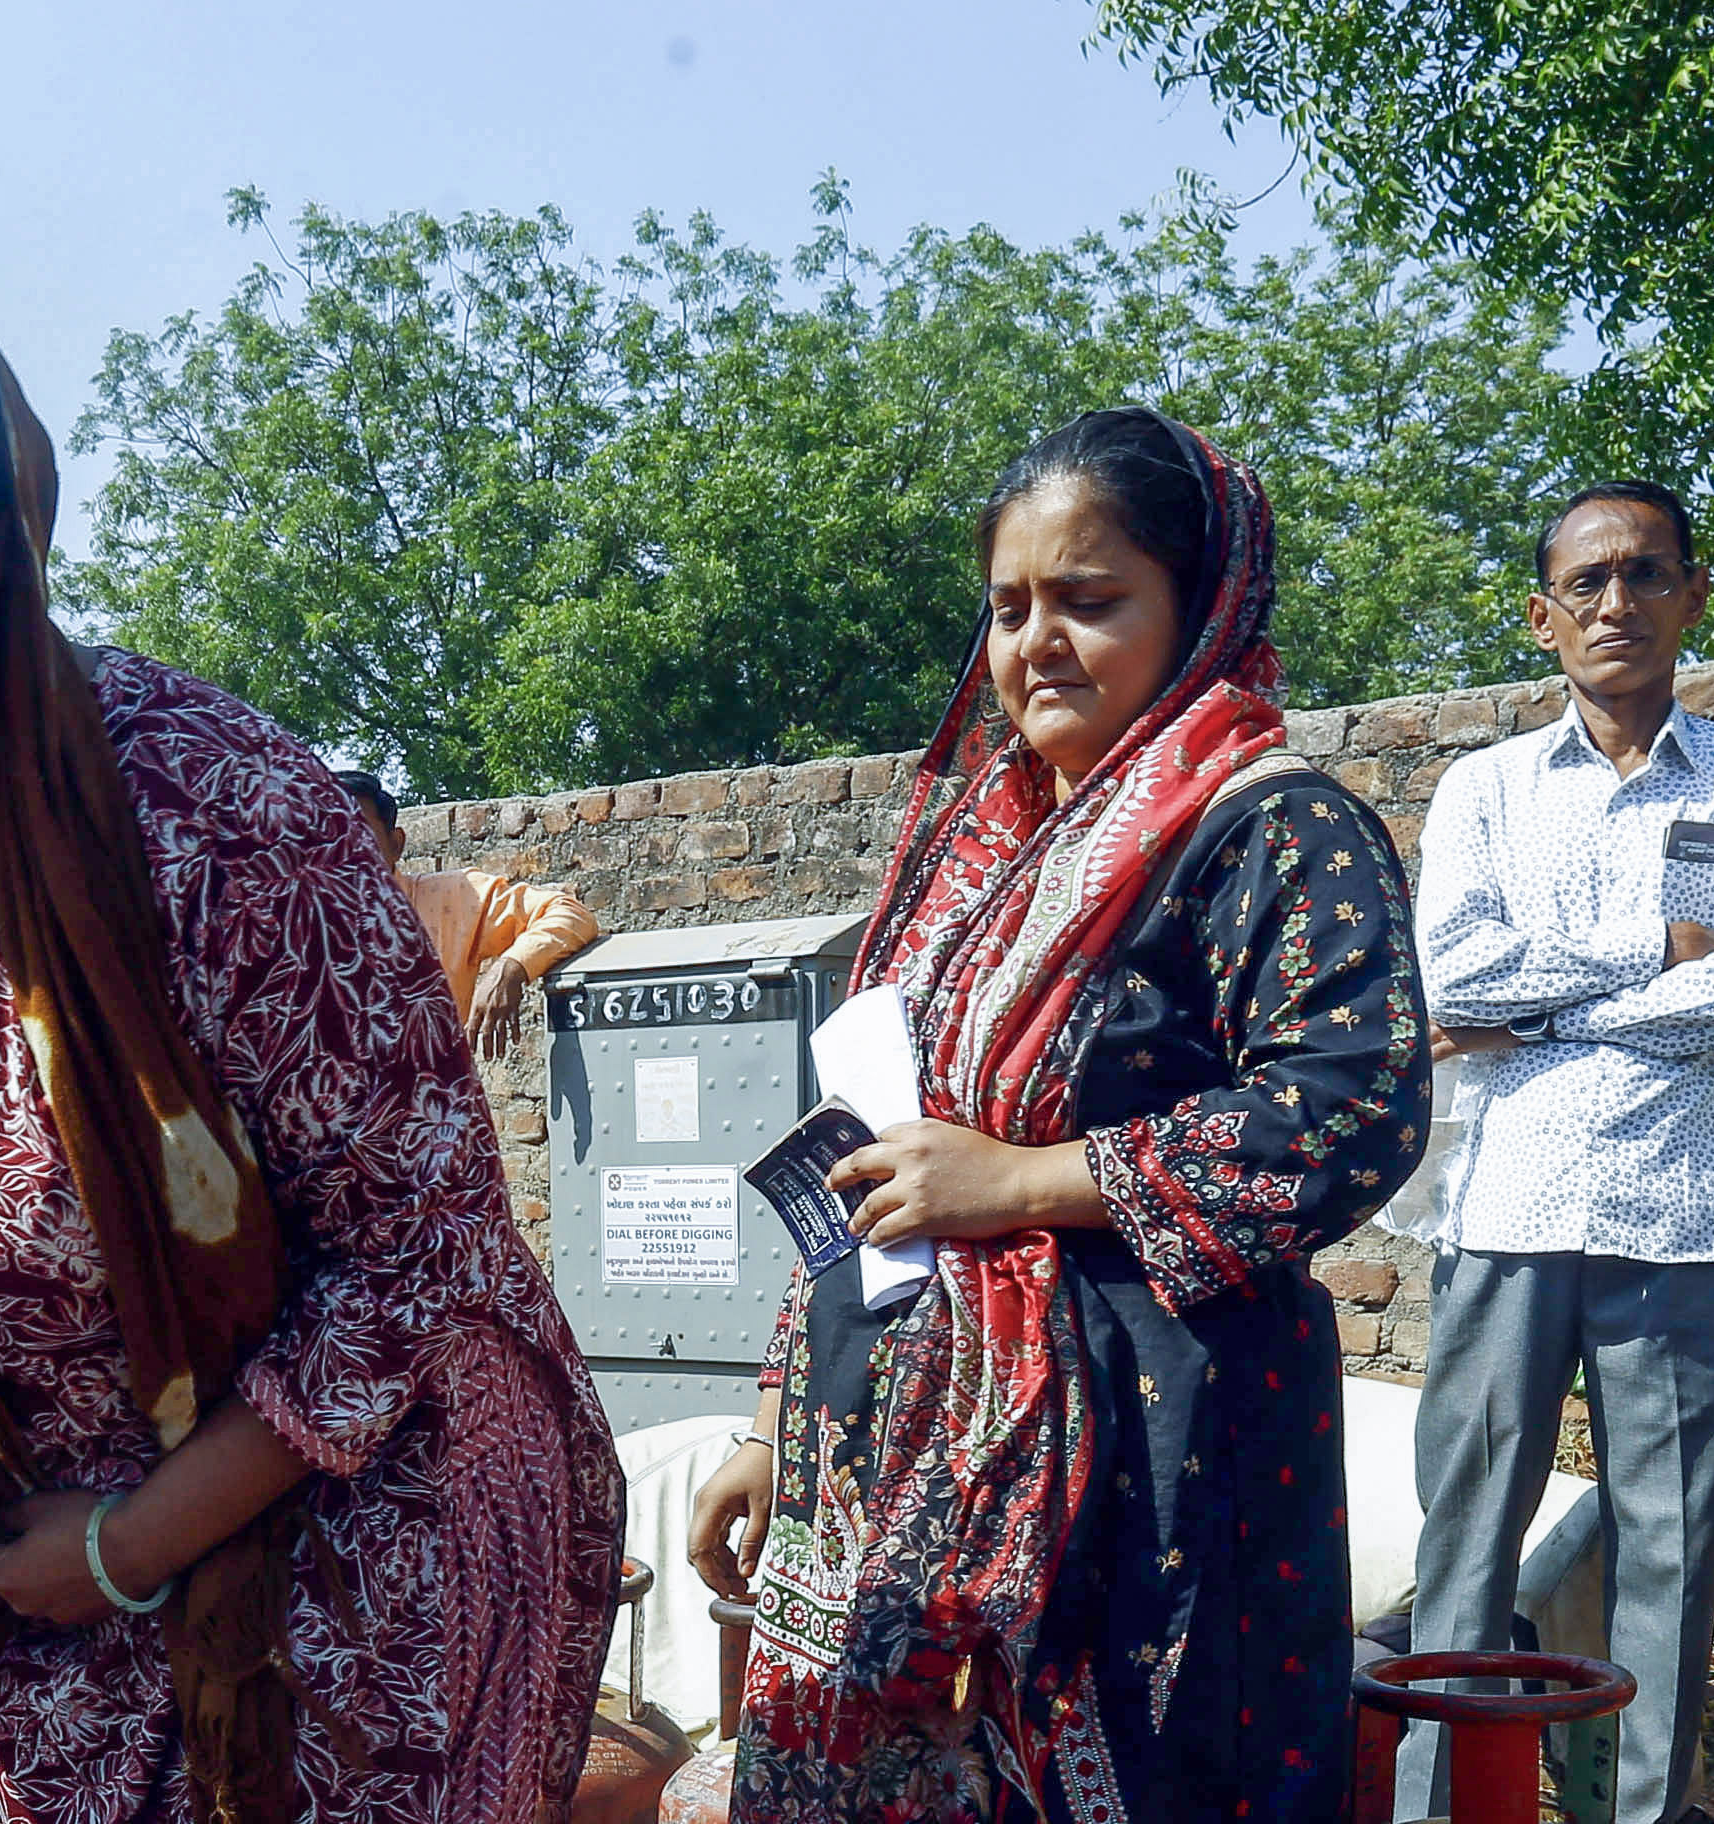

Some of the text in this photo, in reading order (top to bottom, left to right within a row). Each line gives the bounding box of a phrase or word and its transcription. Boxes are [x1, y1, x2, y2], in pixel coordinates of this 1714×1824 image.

[606, 1229, 733, 1240] DIAL BEFORE DIGGING
[641, 1243, 697, 1254] 22551912
